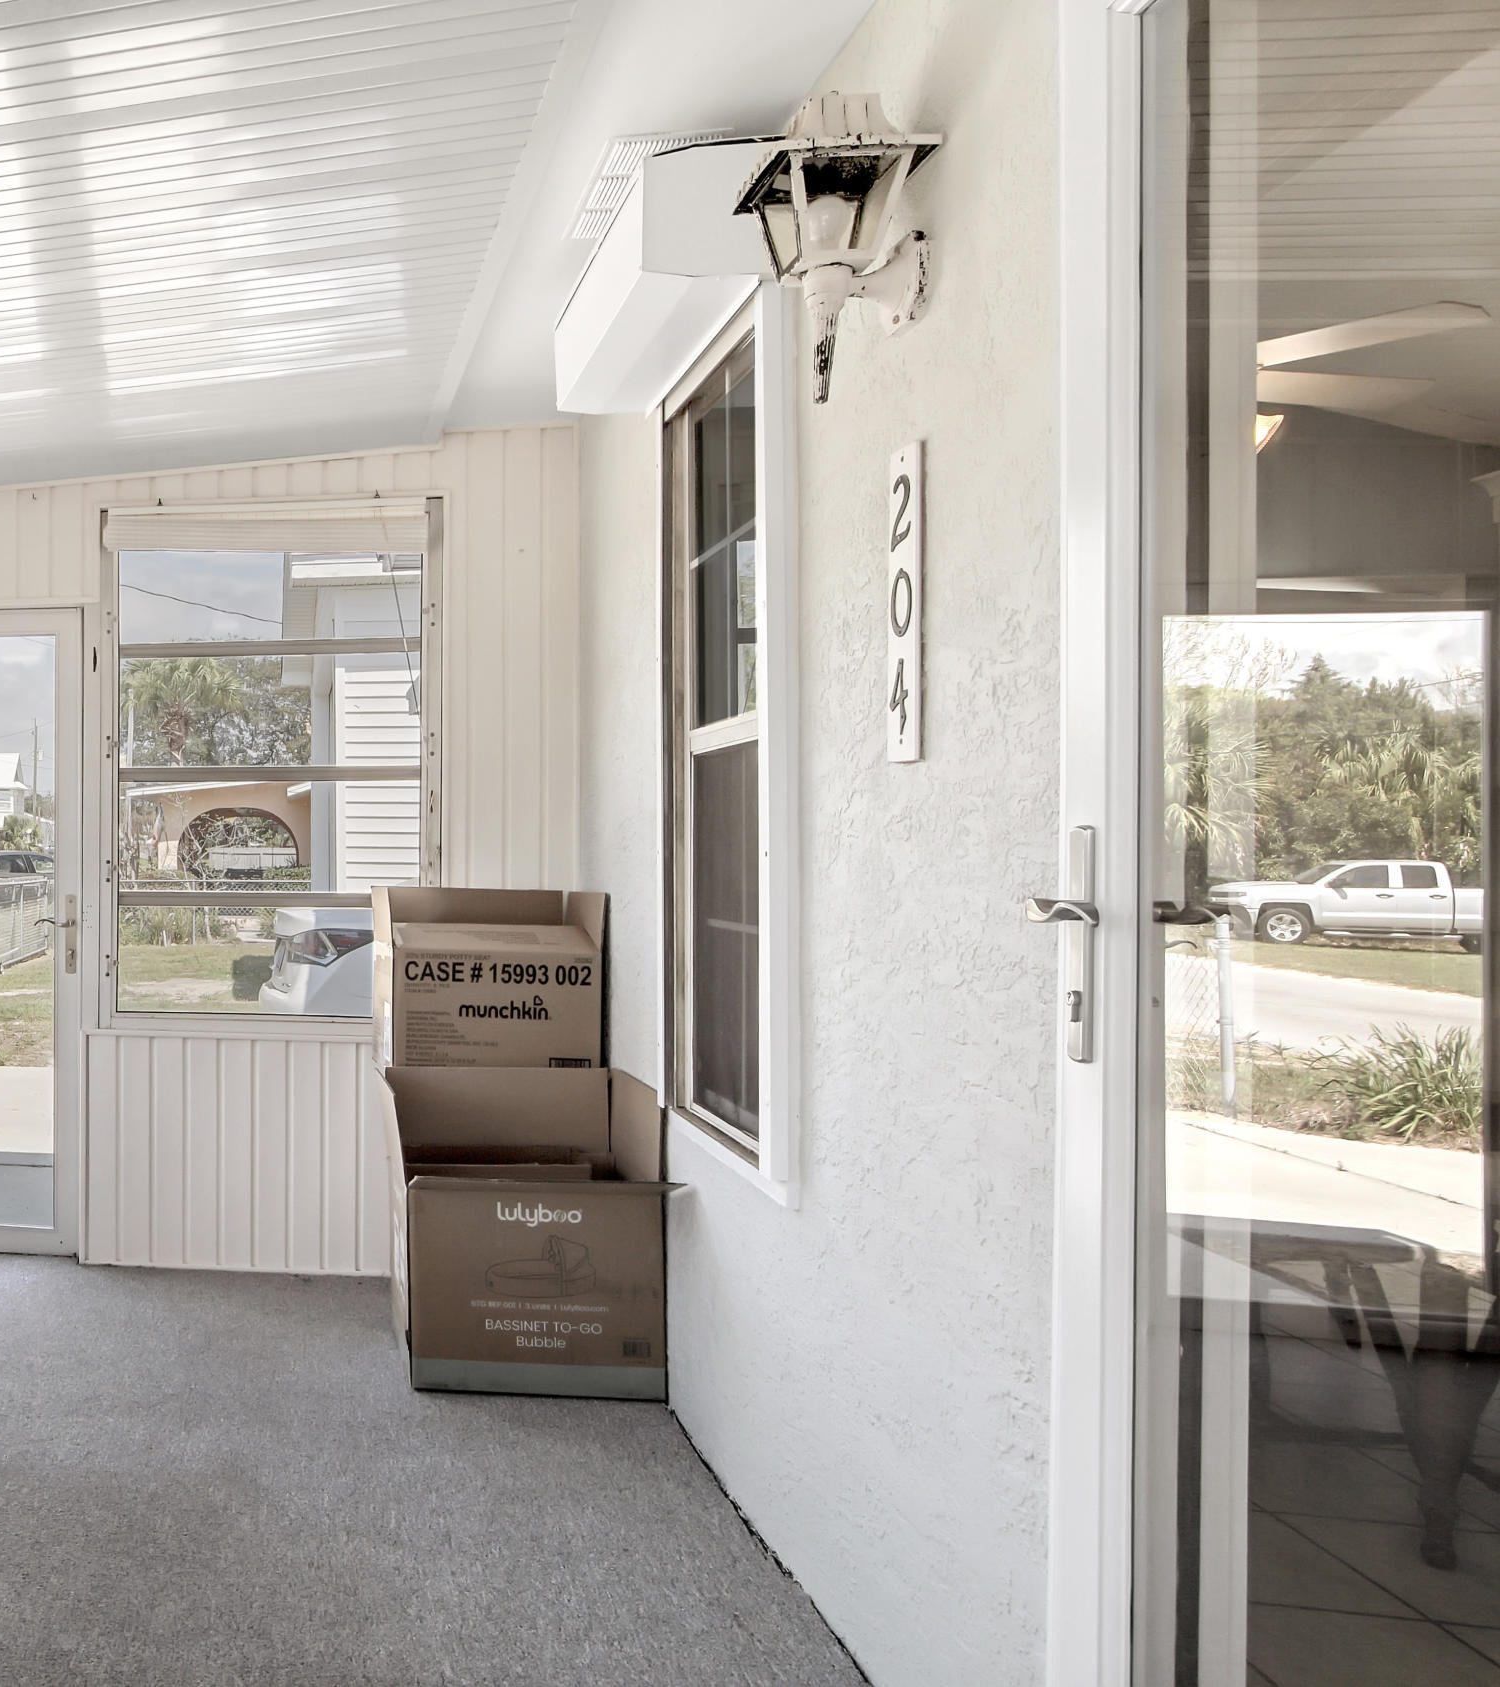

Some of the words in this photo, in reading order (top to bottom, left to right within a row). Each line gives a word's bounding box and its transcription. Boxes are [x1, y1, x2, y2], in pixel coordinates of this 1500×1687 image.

[890, 473, 913, 736] 204
[404, 960, 465, 982] CASE
[470, 962, 484, 983] #
[489, 962, 550, 985] 15993
[555, 964, 592, 986] 002
[458, 995, 549, 1021] munchkin
[485, 1318, 549, 1332] BASSINET
[553, 1320, 603, 1335] TO-GO
[516, 1335, 567, 1349] Bubble
